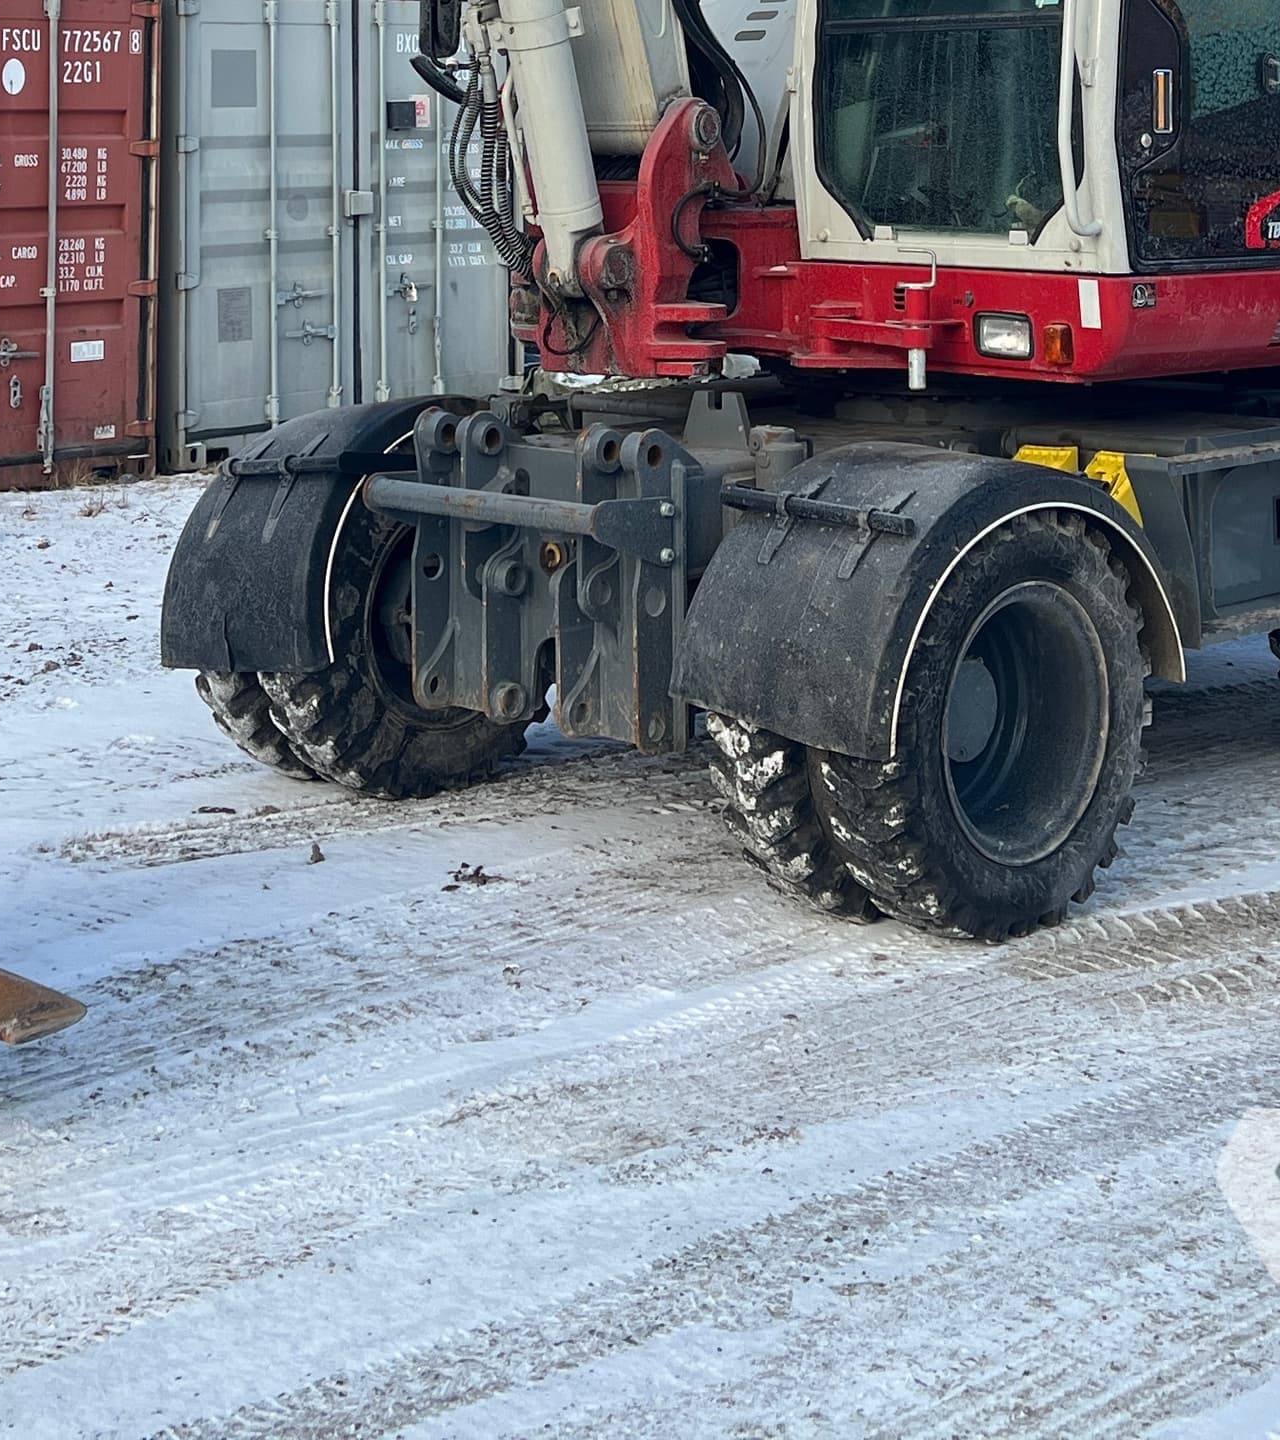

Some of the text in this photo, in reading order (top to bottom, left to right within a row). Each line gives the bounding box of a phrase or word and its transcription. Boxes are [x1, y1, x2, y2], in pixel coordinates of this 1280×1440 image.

[2, 28, 140, 53] FSCU 772567 8
[63, 60, 102, 84] 22G1
[61, 147, 108, 160] 30.480 KG
[14, 154, 39, 167] GROSS
[60, 160, 107, 173] 67.200 LB
[65, 175, 107, 187] 2.220 KG
[64, 188, 106, 201] 4.890 LB
[58, 237, 105, 252] 28.260 KG
[12, 245, 38, 259] CARGO
[58, 251, 105, 265] 62.310 LB
[58, 266, 75, 279] 33.2
